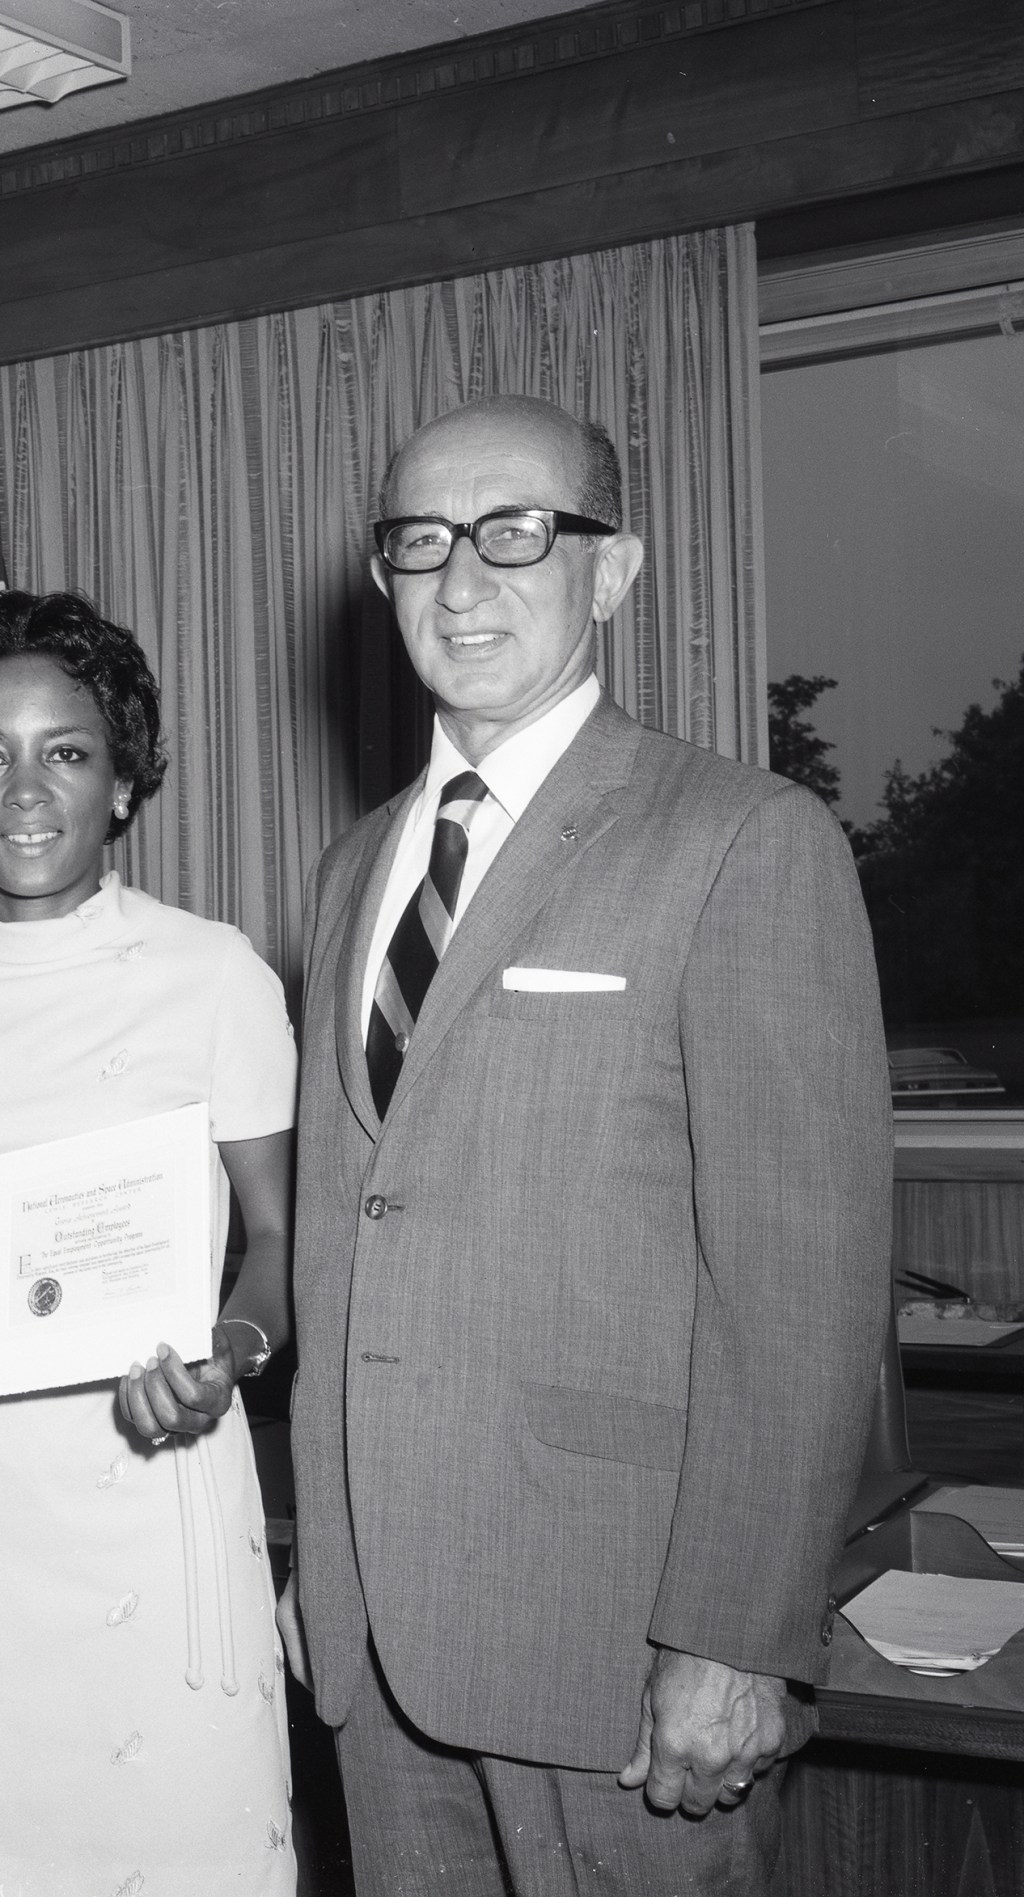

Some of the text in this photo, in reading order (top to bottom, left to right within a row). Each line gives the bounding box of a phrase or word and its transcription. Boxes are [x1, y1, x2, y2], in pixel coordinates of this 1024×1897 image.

[22, 1200, 48, 1213] National
[49, 1193, 85, 1207] Aeronautics
[87, 1188, 97, 1198] and
[98, 1184, 117, 1195] Space
[118, 1173, 164, 1191] Administration
[54, 1227, 96, 1243] Outstanding
[97, 1219, 131, 1235] Employees
[93, 1235, 124, 1248] Opportunity
